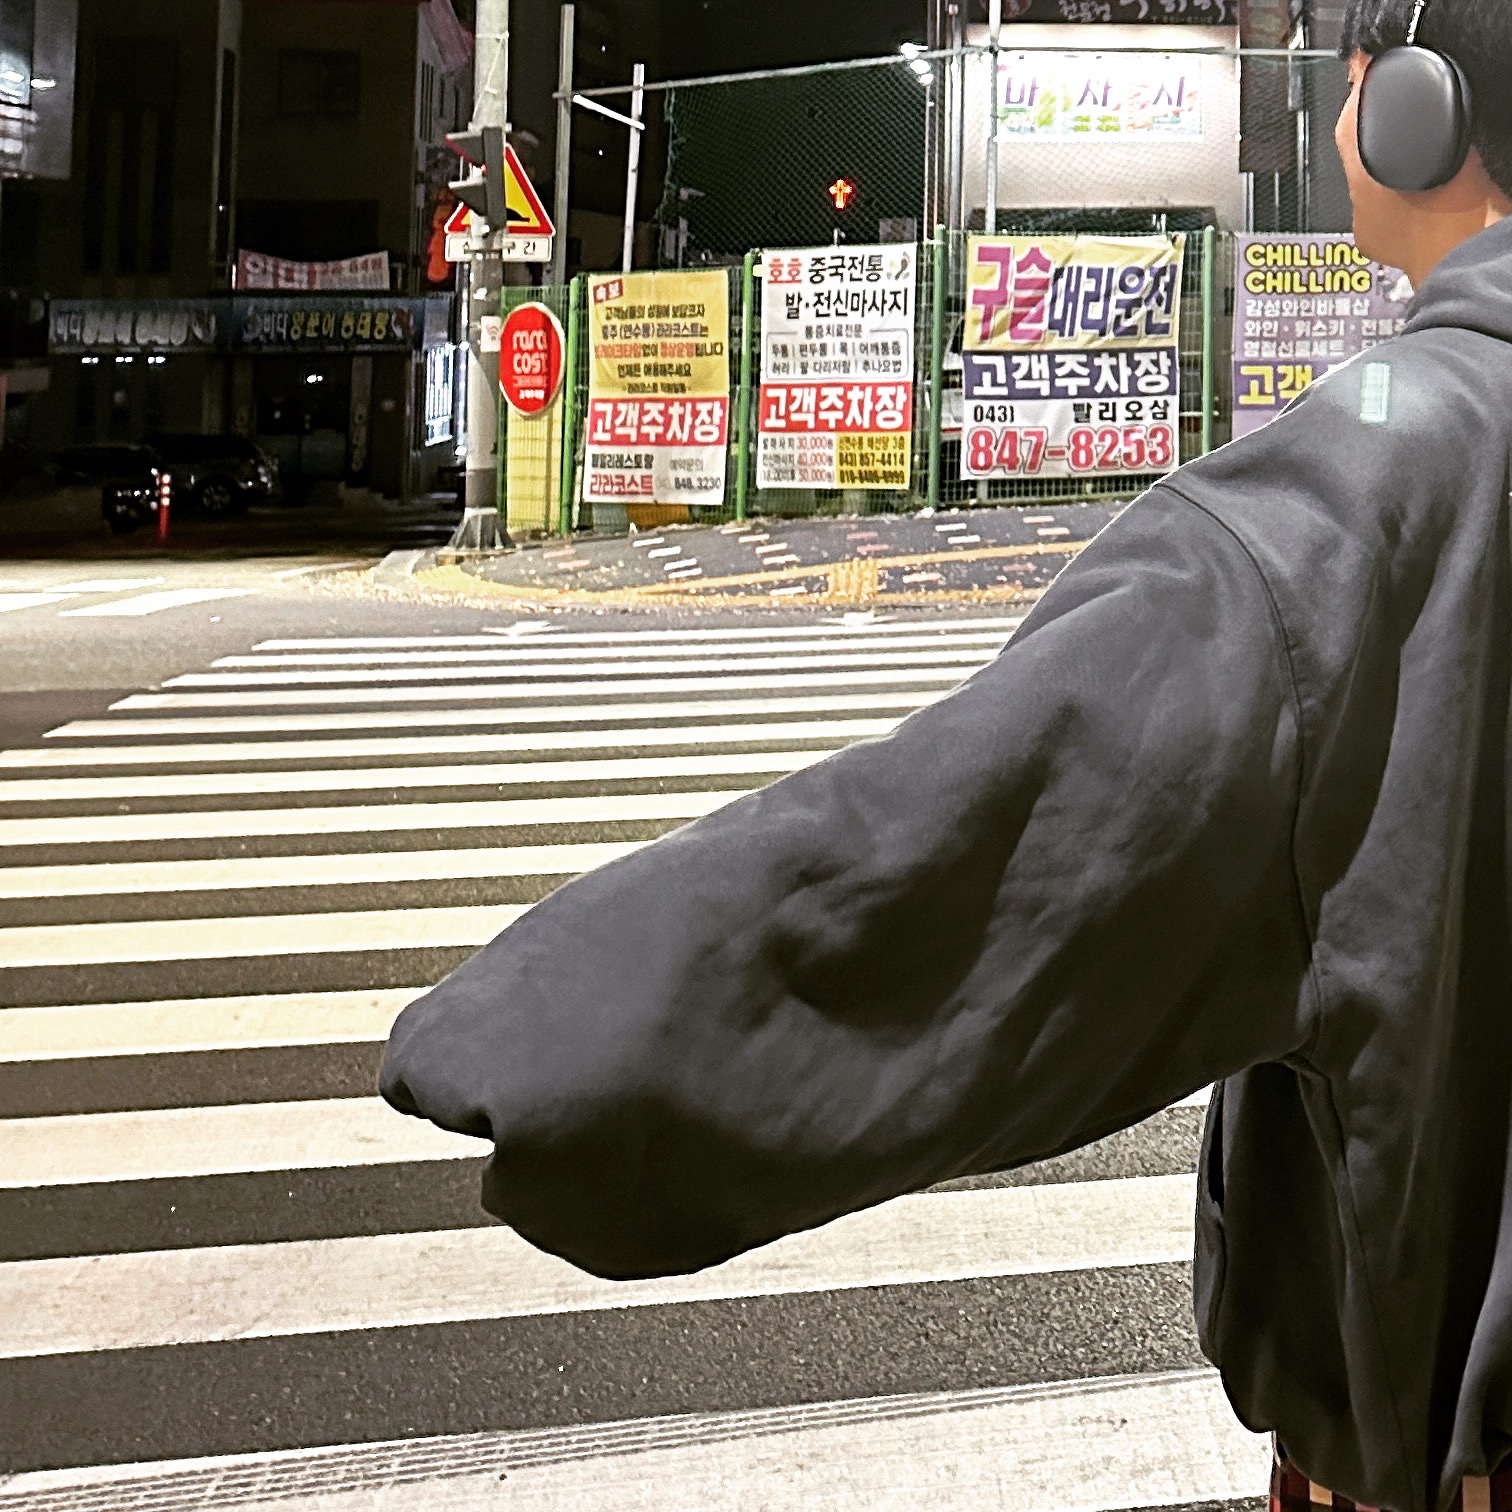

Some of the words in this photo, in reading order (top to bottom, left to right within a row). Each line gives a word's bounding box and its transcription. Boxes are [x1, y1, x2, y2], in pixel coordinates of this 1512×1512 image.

[768, 258, 802, 284] 호호
[808, 254, 883, 284] 중국전통
[1245, 269, 1371, 294] CHILLING
[1046, 264, 1178, 338] 대리운전
[1245, 320, 1278, 337] 와인
[972, 353, 1172, 395] 고객주차장
[592, 401, 724, 443] 고객주차장
[764, 386, 908, 430] 고객주차장
[968, 426, 1173, 476] 847-8253
[590, 473, 654, 495] 라라코스트
